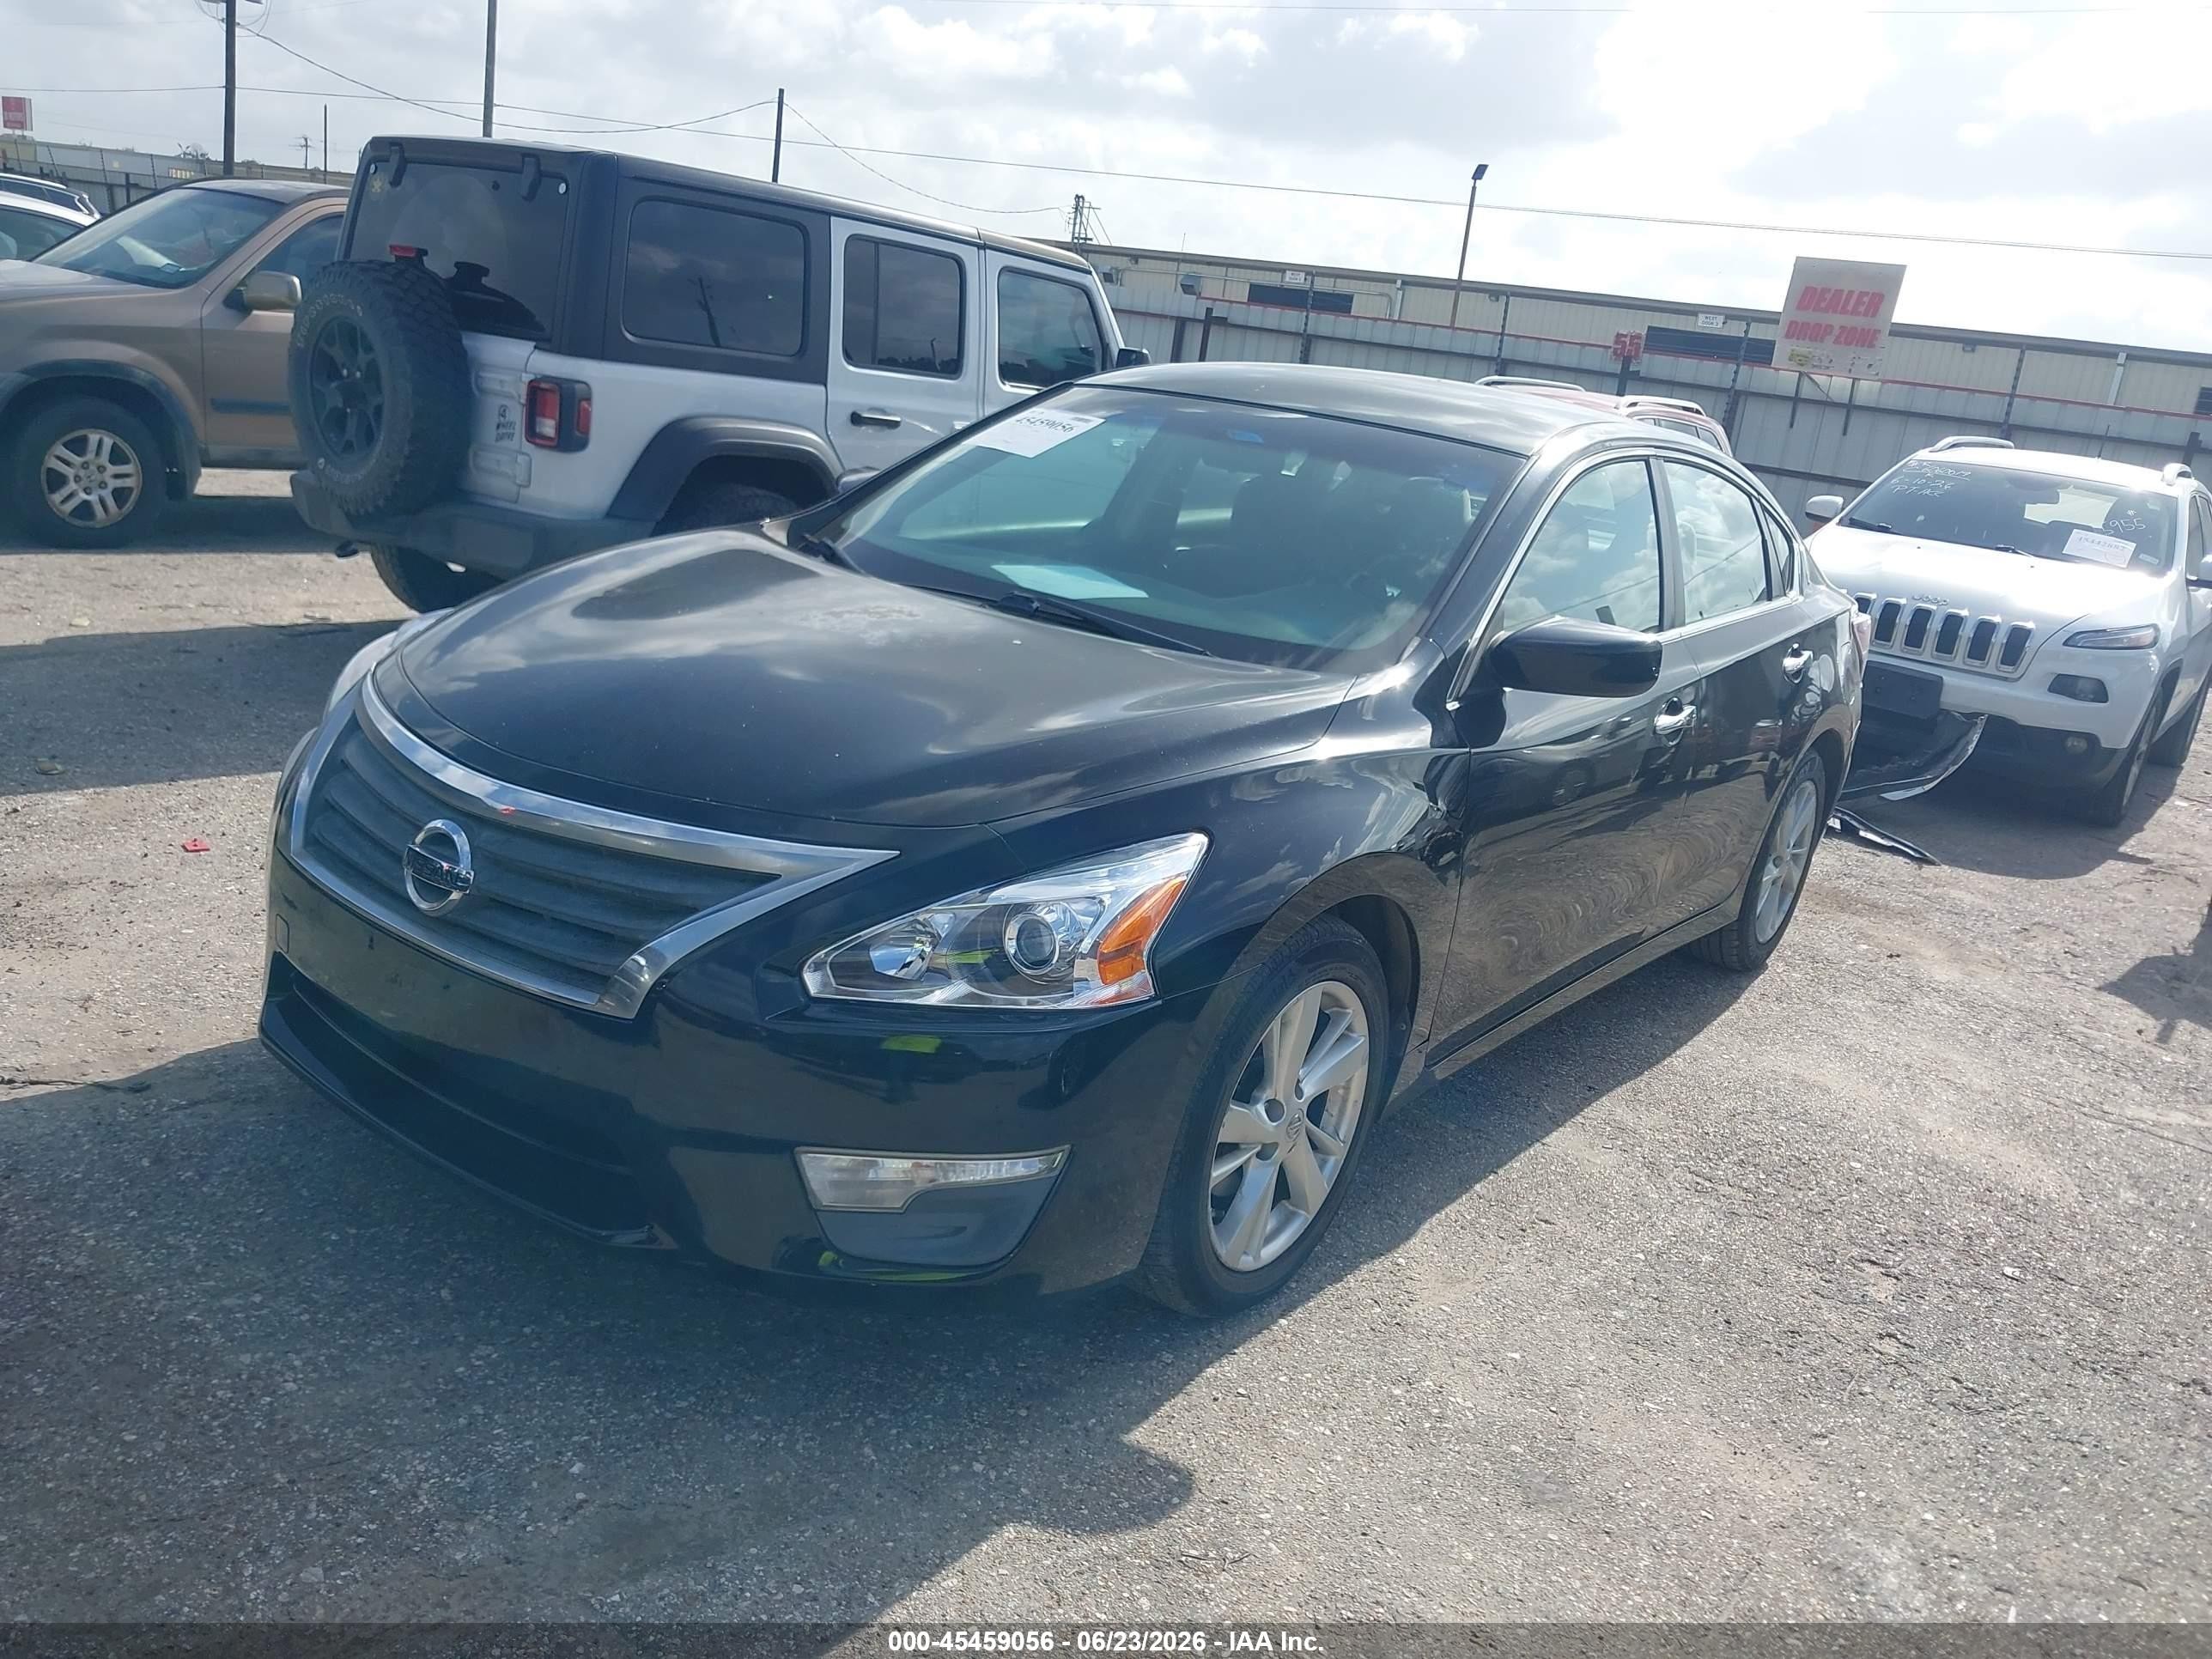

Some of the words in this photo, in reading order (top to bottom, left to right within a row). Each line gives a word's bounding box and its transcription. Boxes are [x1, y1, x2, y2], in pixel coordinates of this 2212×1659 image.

[1796, 285, 1886, 319] DEALER
[1784, 319, 1835, 343] DROP
[1832, 325, 1881, 349] ZONE
[411, 854, 470, 889] NISSAN
